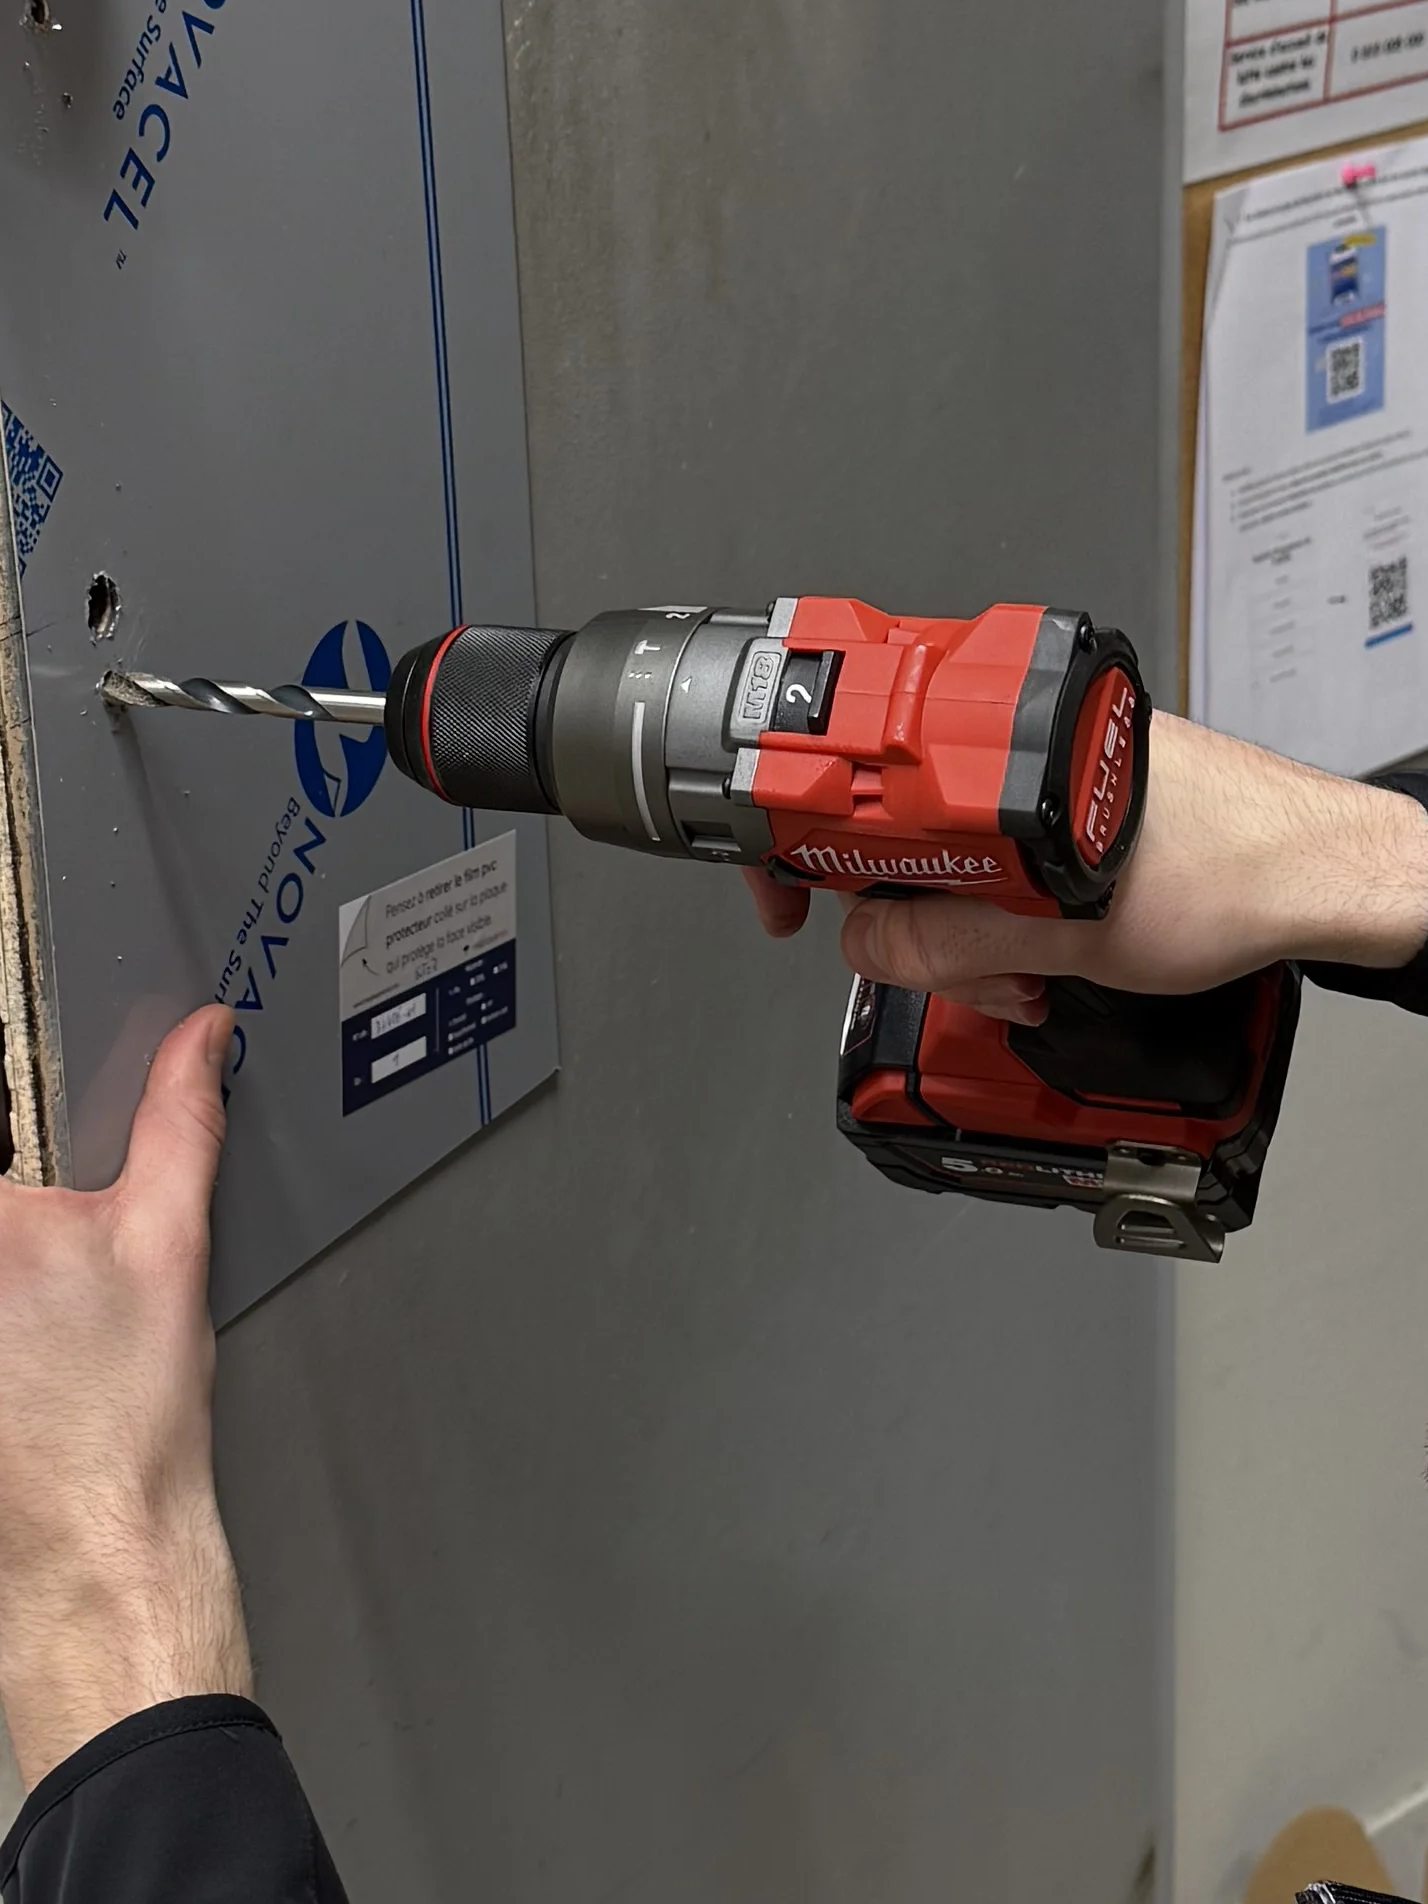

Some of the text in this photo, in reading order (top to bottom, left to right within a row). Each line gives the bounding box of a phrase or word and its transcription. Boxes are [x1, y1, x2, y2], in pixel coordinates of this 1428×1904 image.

[113, 14, 167, 122] Surface
[741, 654, 774, 721] M18
[1085, 686, 1128, 843] FUEL
[256, 796, 301, 894] Beyond
[790, 843, 1003, 878] Milwaukee
[236, 897, 264, 946] The
[385, 895, 417, 919] Pensez
[425, 879, 453, 901] retirer
[454, 873, 462, 888] le
[464, 866, 480, 883] film
[481, 860, 498, 878] pvc
[385, 881, 508, 950] protecteur collé sur la plaque
[386, 957, 400, 975] qui
[436, 934, 446, 949] la
[447, 927, 465, 945] face
